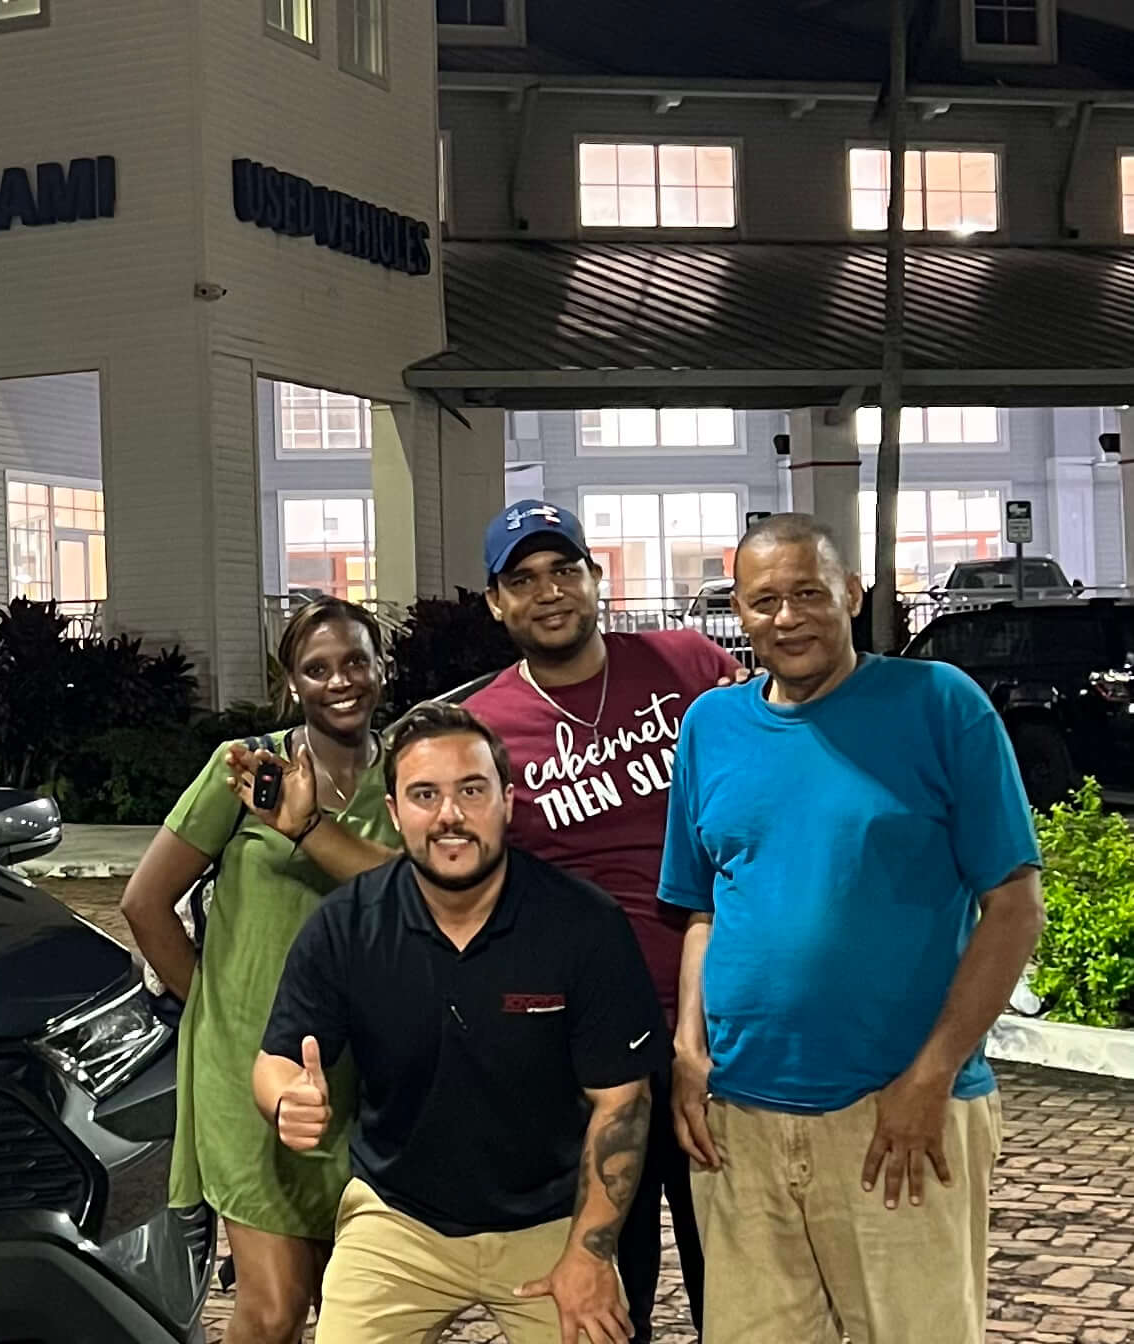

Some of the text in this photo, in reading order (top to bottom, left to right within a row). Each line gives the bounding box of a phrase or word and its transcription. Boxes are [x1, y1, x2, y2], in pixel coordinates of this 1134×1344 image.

[232, 158, 431, 276] USED VEHICLES
[524, 692, 681, 790] cabernet
[533, 771, 623, 830] THEN
